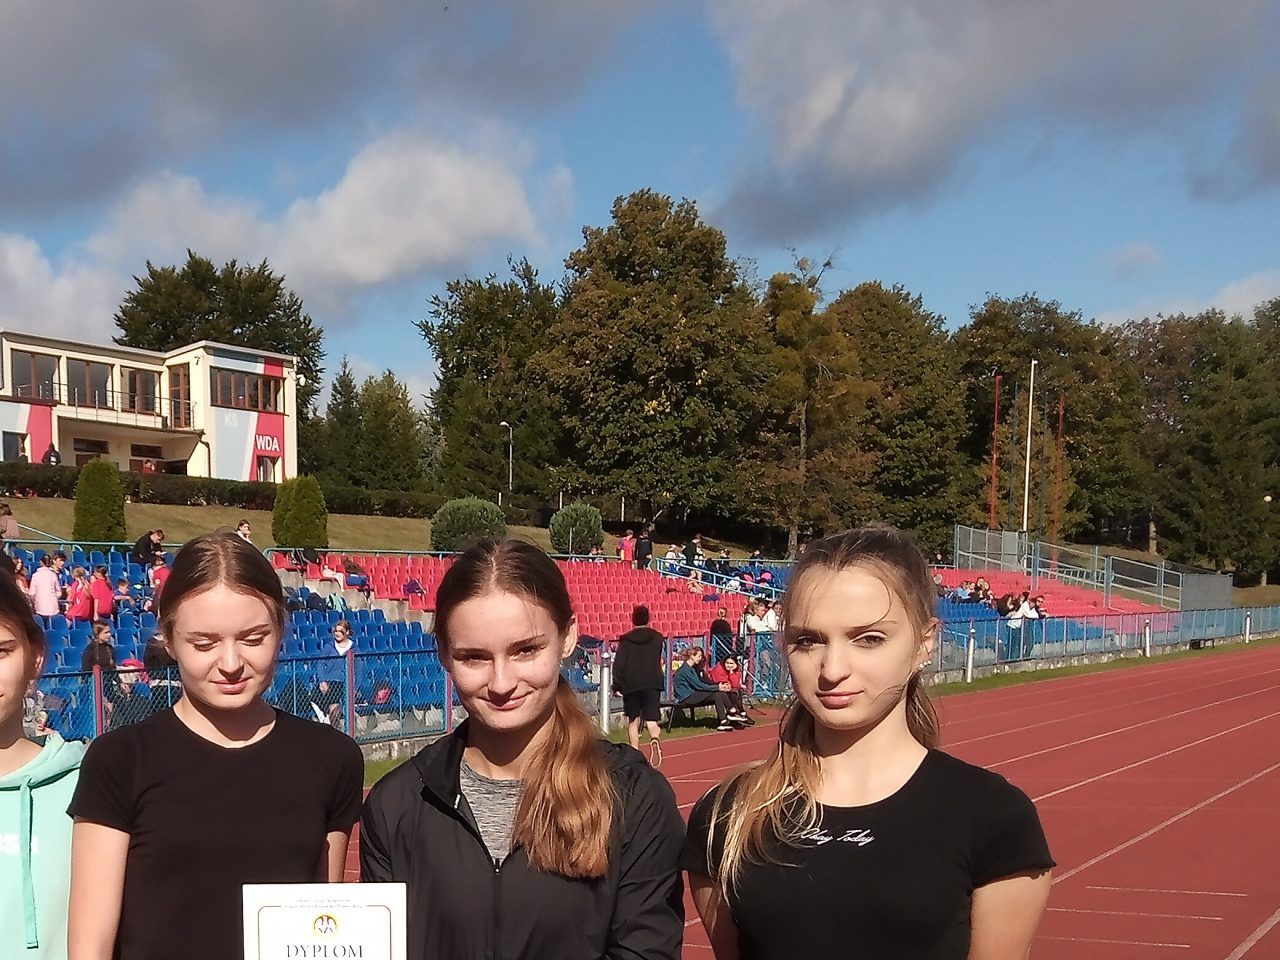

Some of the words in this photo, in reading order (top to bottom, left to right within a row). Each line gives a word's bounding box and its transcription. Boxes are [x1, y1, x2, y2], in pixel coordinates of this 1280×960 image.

[224, 413, 238, 427] KS
[255, 434, 280, 452] WDA
[836, 829, 875, 847] Today
[286, 944, 364, 958] DYPLOM
